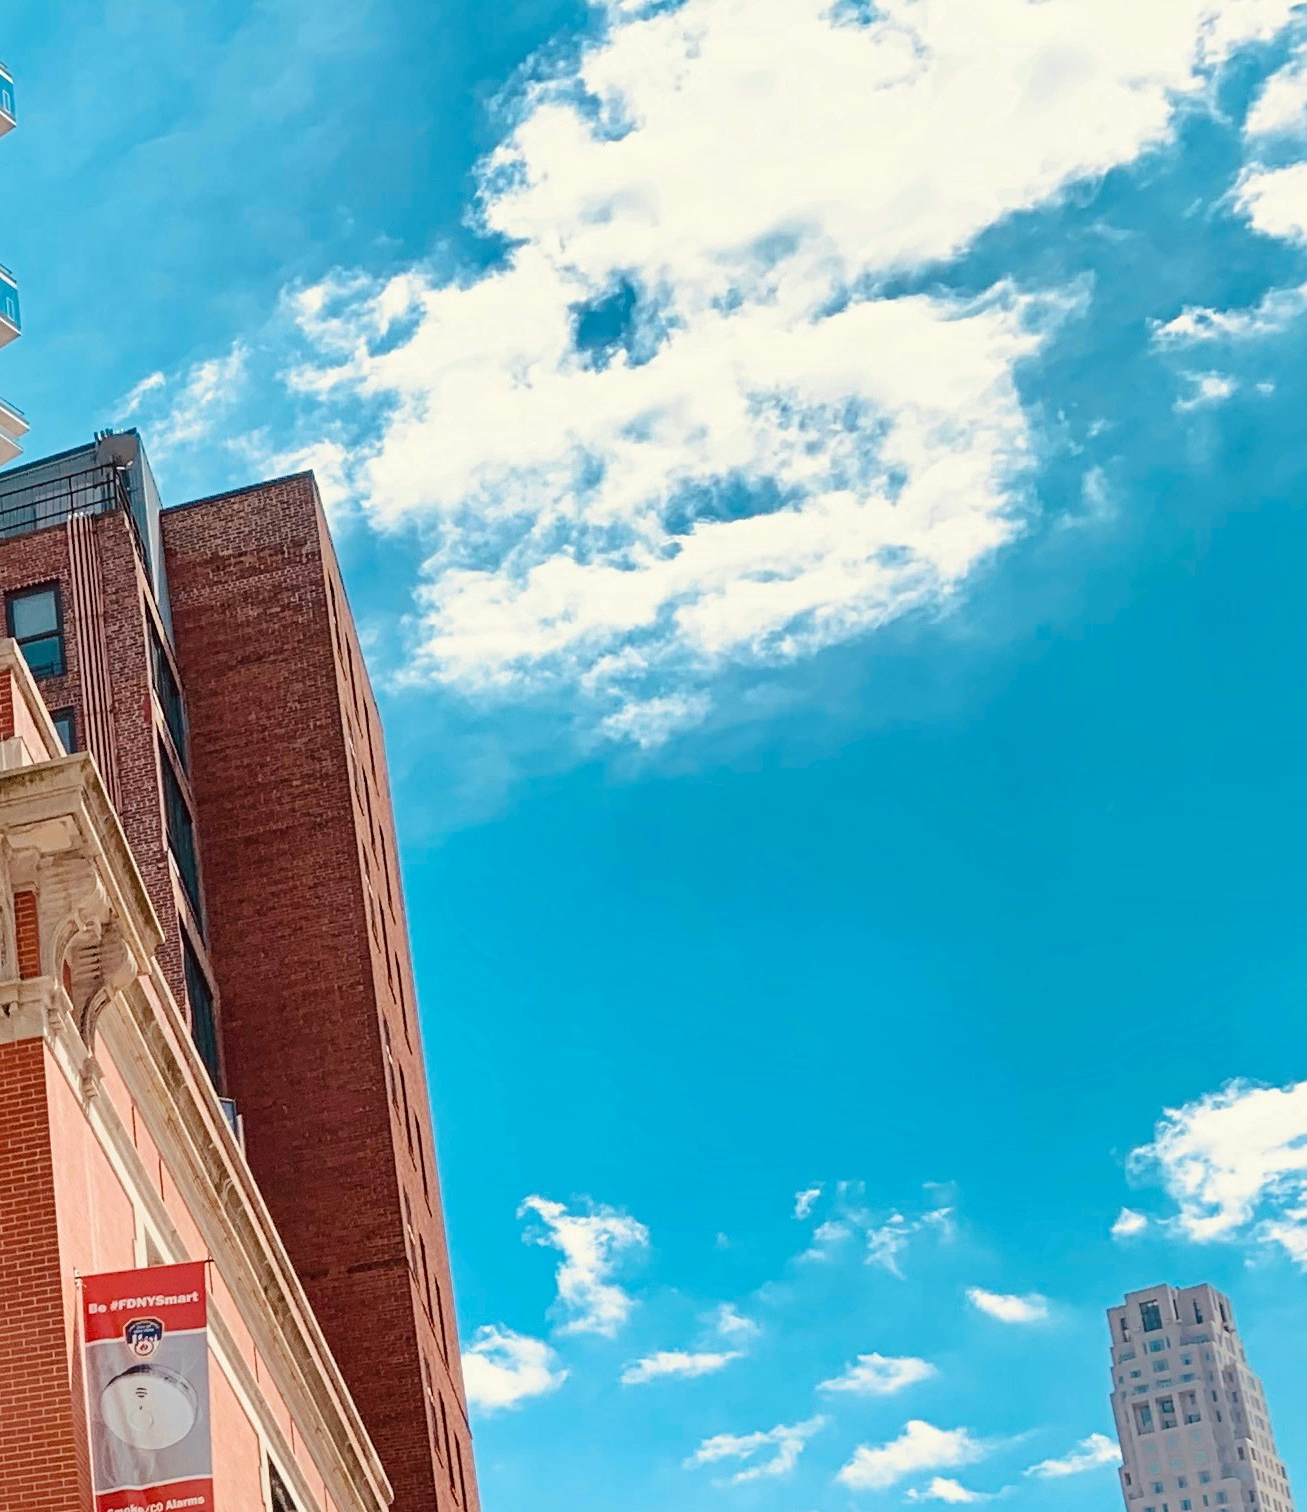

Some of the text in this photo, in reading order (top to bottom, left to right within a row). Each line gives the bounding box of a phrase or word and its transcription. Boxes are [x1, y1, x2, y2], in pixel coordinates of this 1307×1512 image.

[88, 1291, 199, 1314] Be #FDNYSmart
[166, 1496, 205, 1510] Alarms
